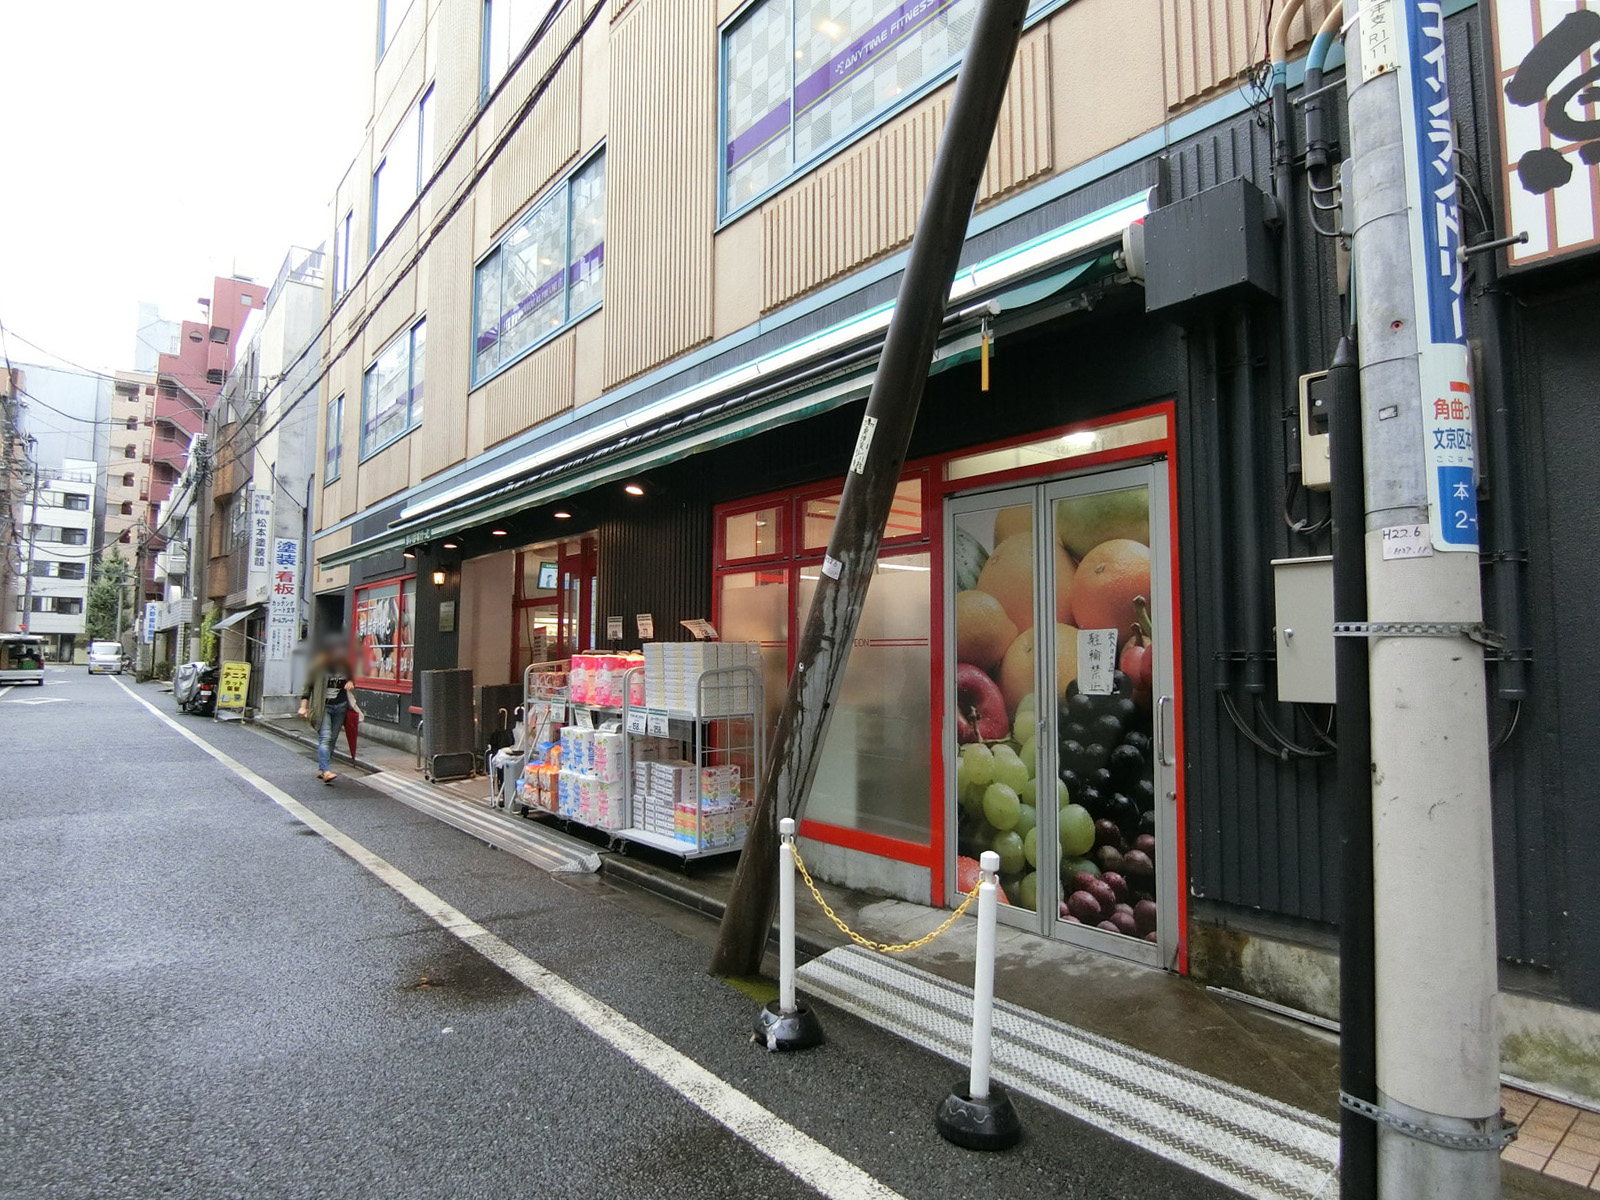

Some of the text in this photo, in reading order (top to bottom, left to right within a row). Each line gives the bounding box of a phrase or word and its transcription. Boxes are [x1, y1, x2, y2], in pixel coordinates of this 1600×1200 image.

[844, 0, 935, 70] ANYTIME FITNESS
[1417, 2, 1465, 340] コインランドリー
[1452, 481, 1469, 501] 本
[1382, 526, 1421, 540] H22.6
[276, 541, 297, 566] 塗装
[274, 571, 296, 595] 看板
[1088, 632, 1105, 692] 駐輪禁止
[223, 671, 248, 680] テニス
